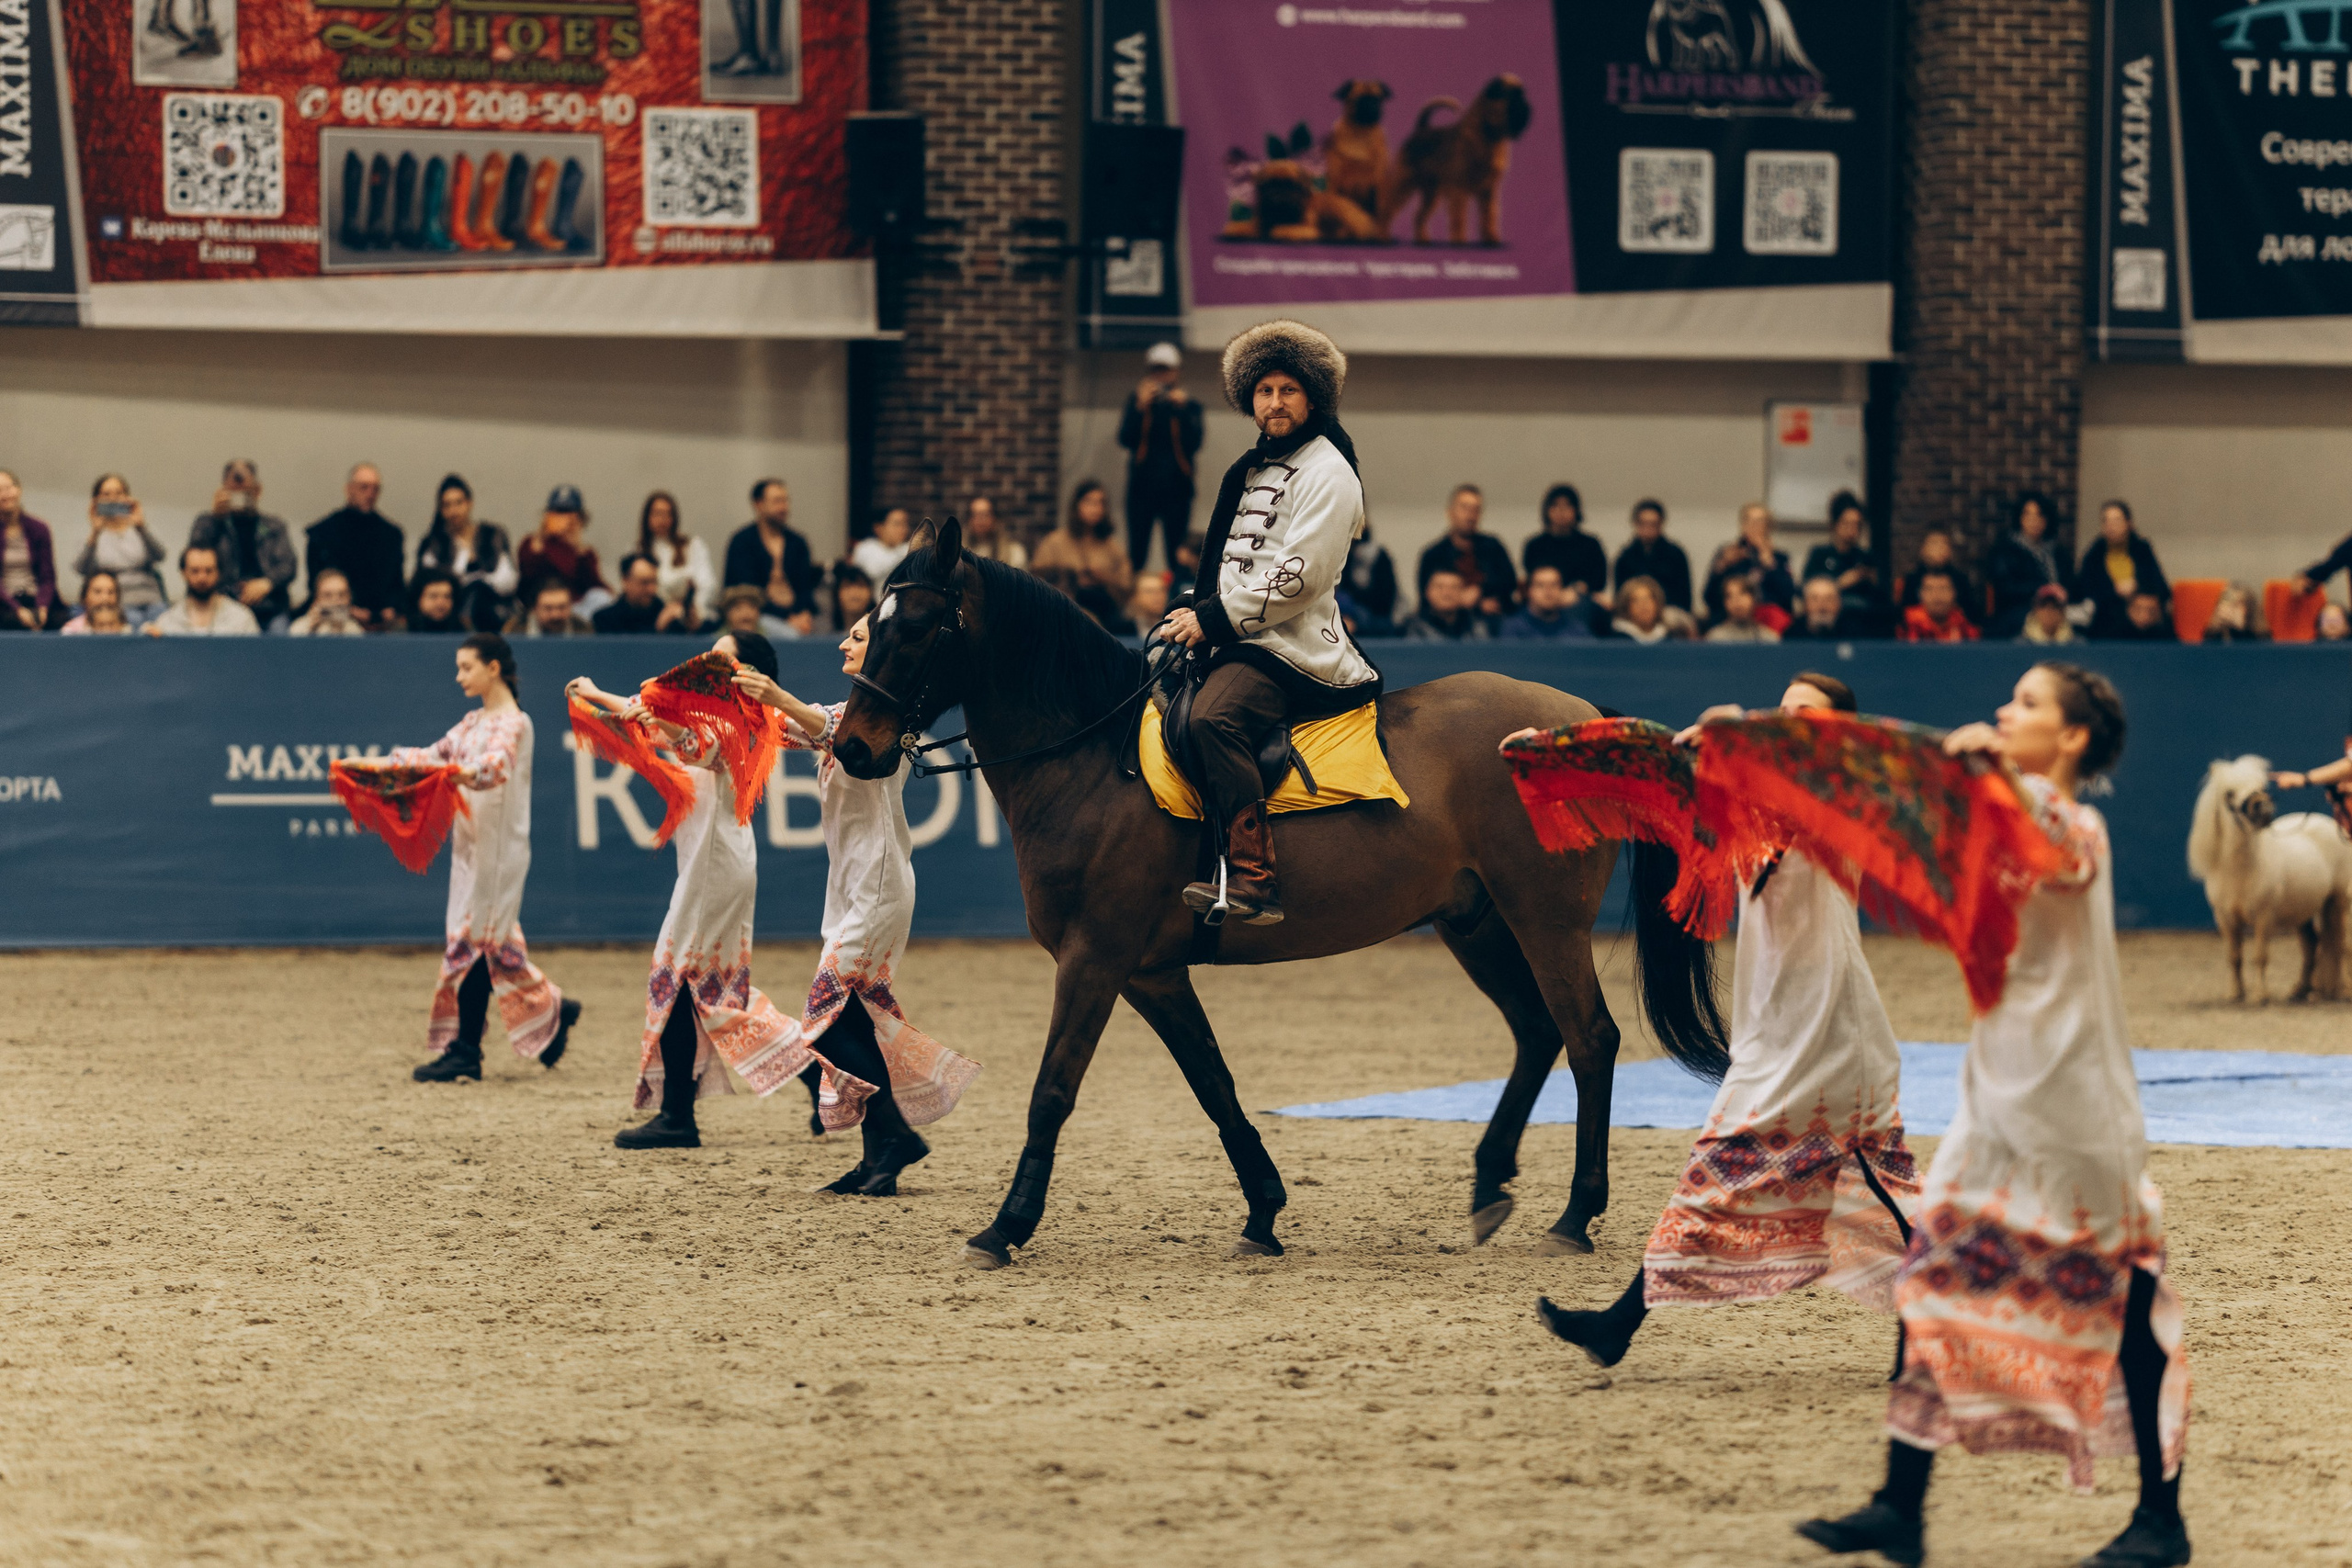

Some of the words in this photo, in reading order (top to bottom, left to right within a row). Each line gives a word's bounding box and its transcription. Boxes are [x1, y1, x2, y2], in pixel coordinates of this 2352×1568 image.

[404, 13, 641, 58] SHOES
[2231, 58, 2352, 96] THE
[341, 86, 458, 125] 8(902)
[465, 90, 636, 126] 208-50-10
[2119, 55, 2154, 228] MAXIMA
[2257, 234, 2316, 265] для
